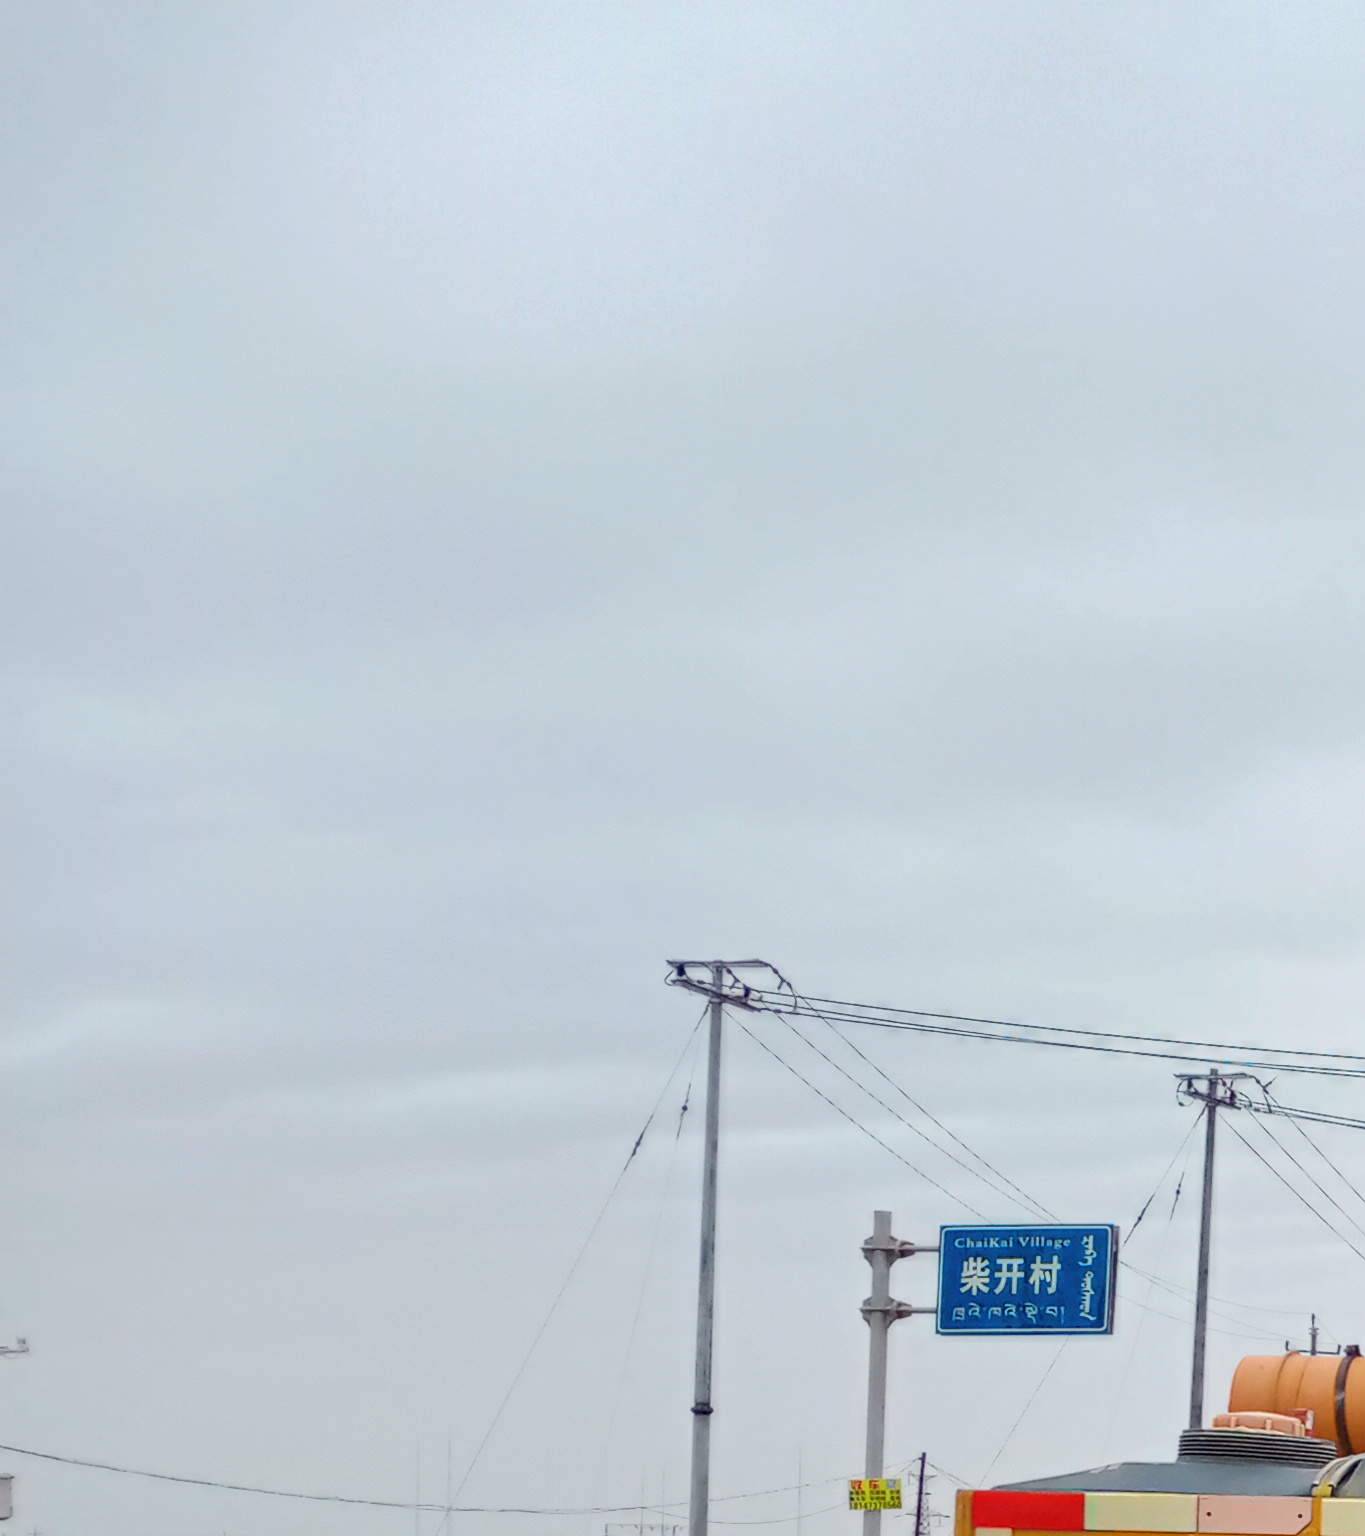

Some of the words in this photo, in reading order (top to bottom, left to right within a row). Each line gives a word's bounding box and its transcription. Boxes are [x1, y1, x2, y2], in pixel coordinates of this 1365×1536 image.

[954, 1236, 1013, 1249] ChaiKai
[1018, 1235, 1071, 1250] Village
[959, 1255, 1062, 1296] 柴开村
